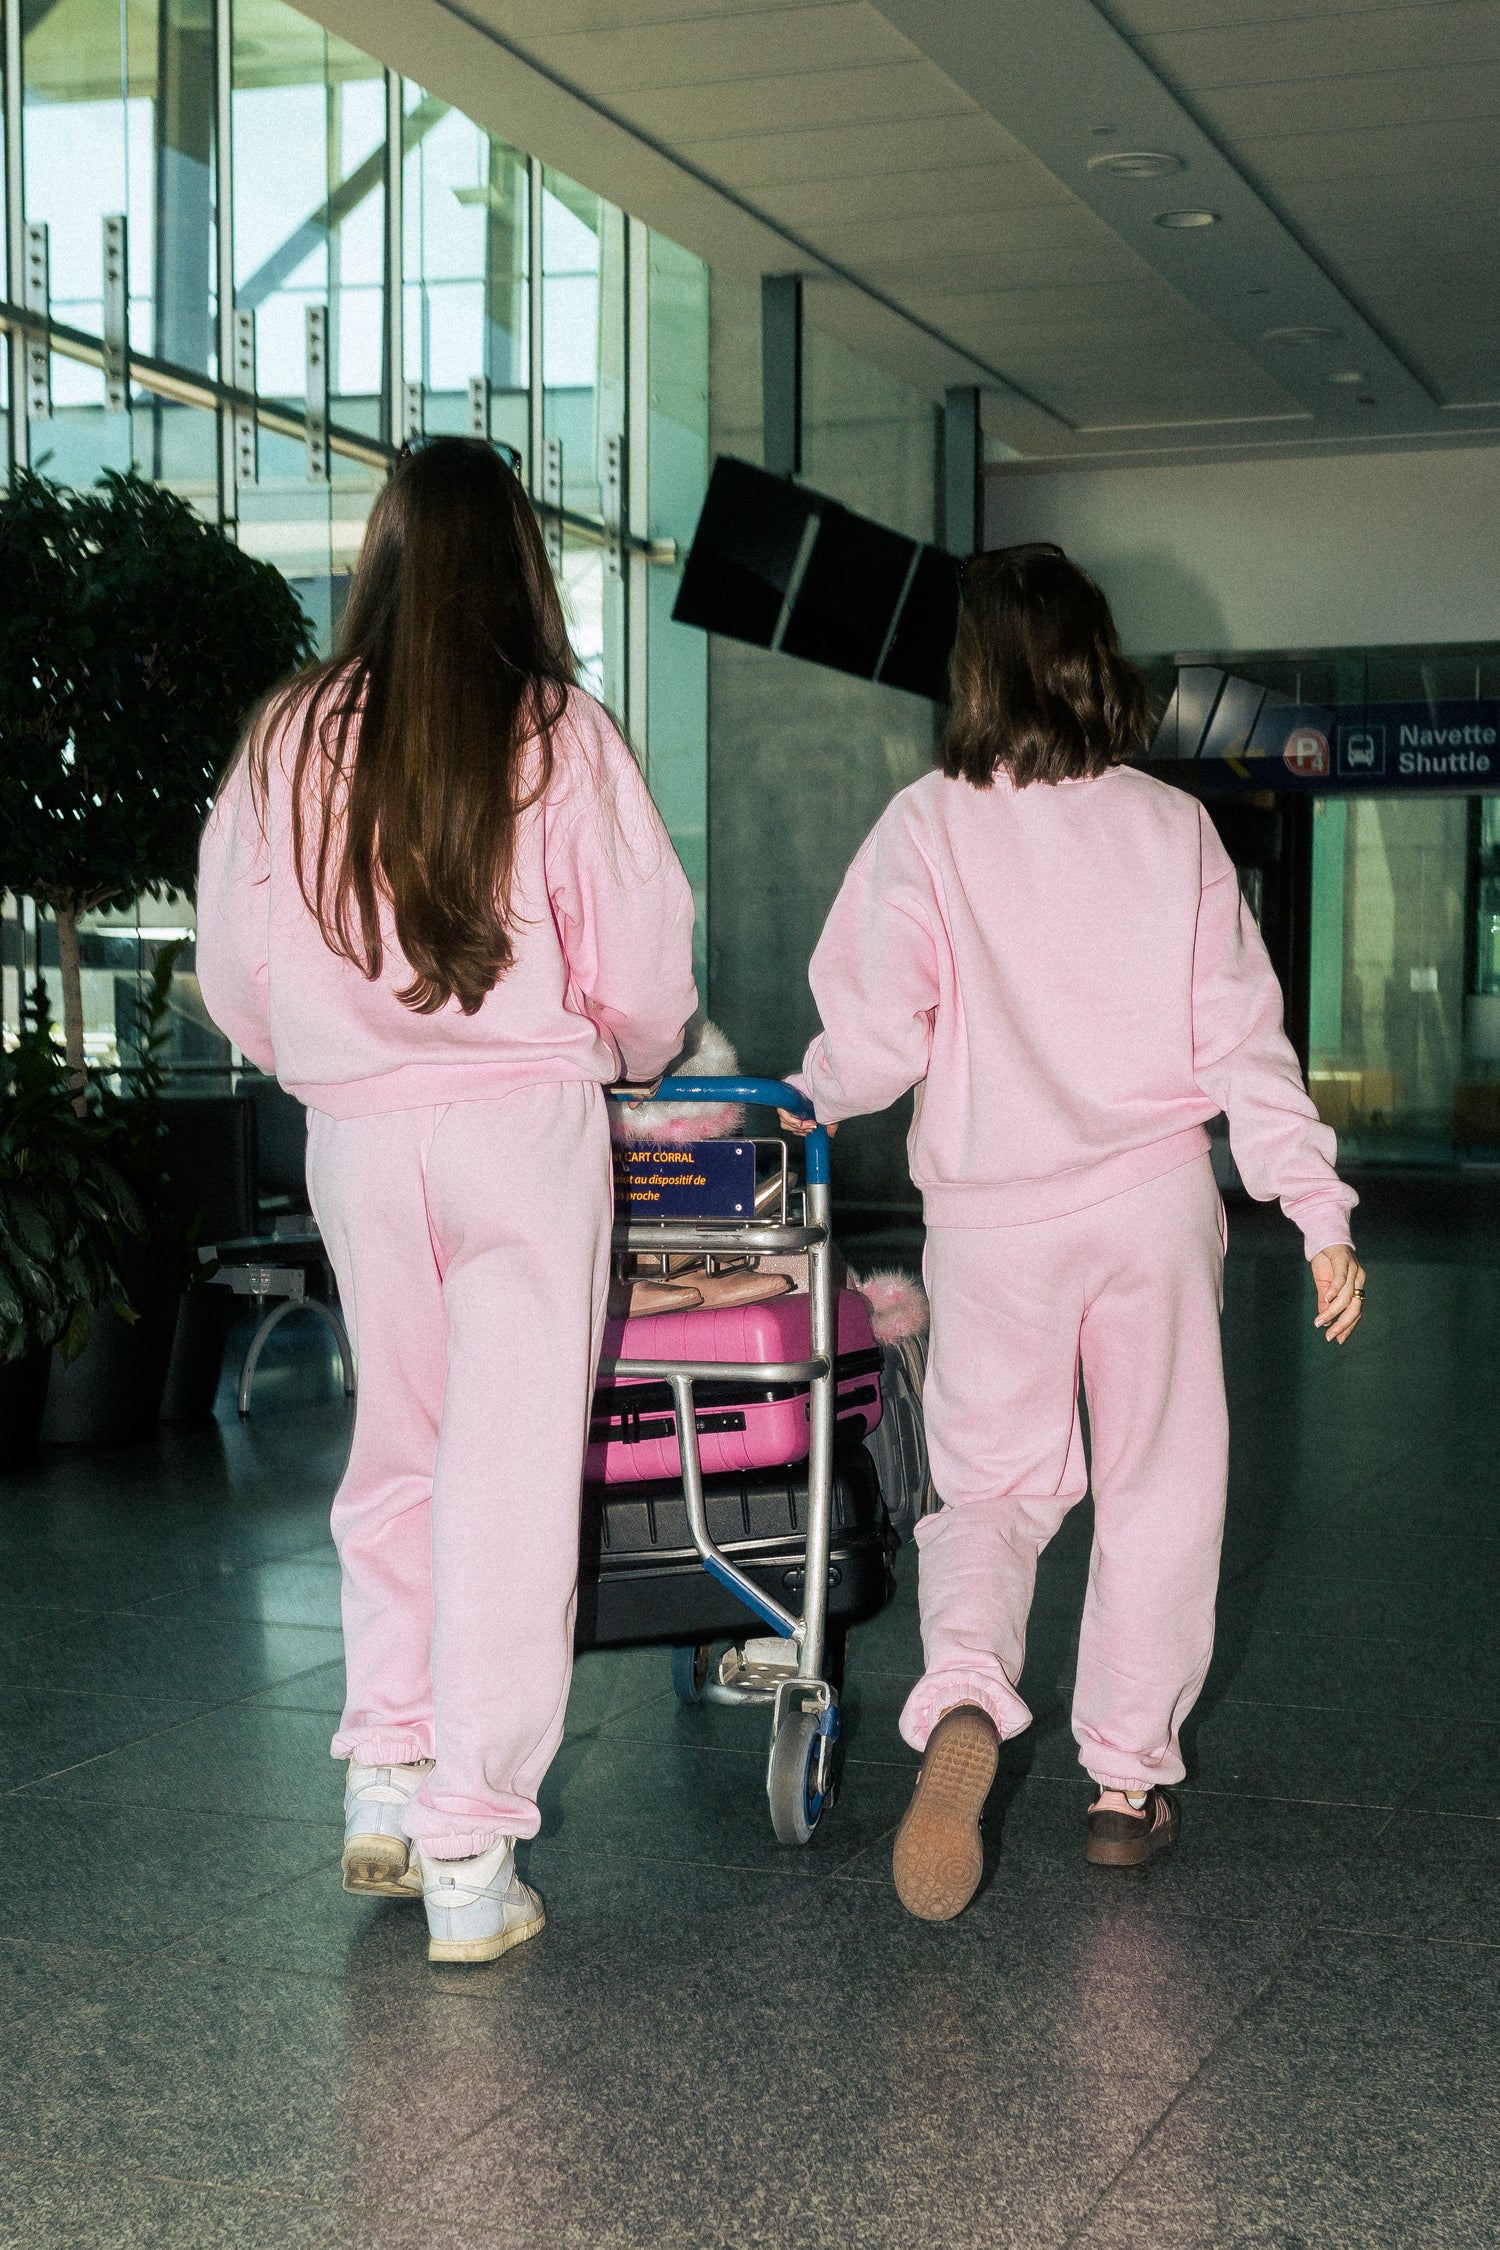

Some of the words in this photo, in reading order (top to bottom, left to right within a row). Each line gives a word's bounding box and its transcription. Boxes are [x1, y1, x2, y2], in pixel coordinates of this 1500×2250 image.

[1399, 724, 1497, 747] Navette
[1399, 750, 1491, 774] Shuttle
[624, 1151, 651, 1163] CART
[652, 1151, 695, 1163] CORRAL
[634, 1176, 648, 1185] au
[648, 1173, 694, 1187] dispositif
[693, 1174, 707, 1186] de
[626, 1190, 660, 1203] proche
